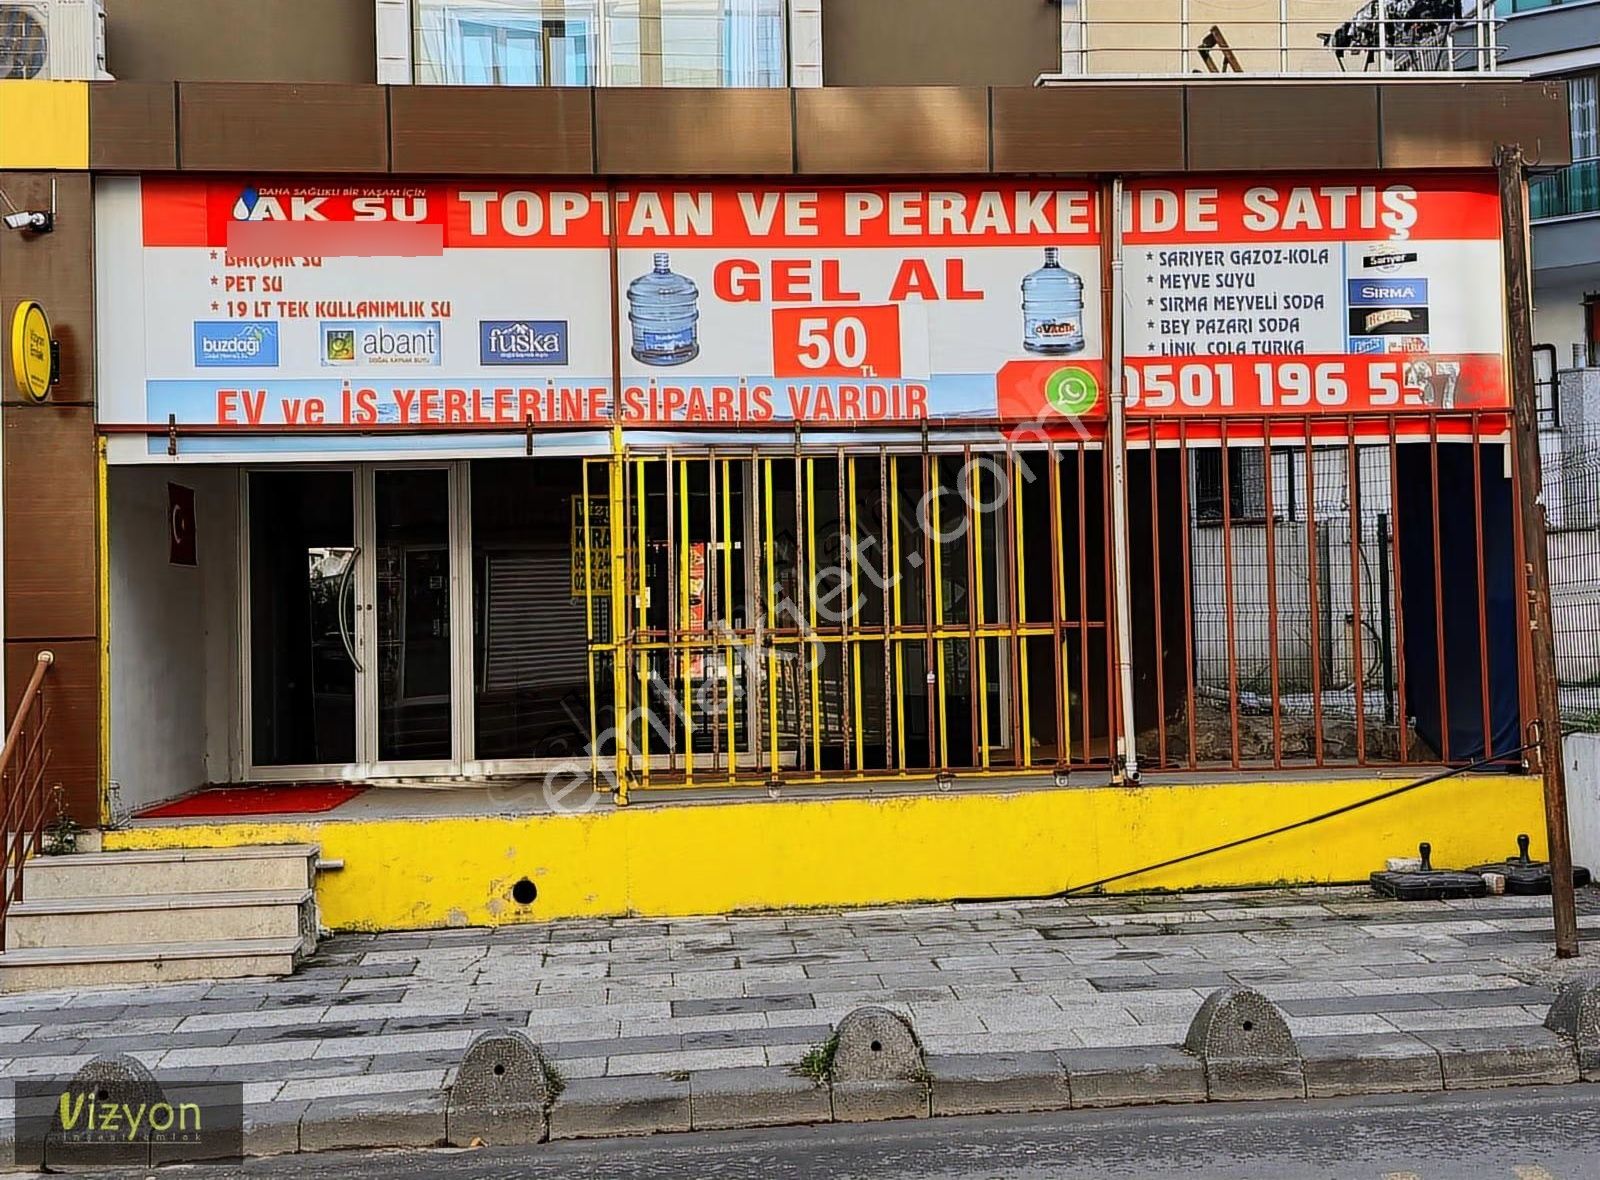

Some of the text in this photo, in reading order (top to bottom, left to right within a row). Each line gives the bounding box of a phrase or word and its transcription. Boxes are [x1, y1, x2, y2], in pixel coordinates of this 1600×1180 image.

[258, 187, 290, 197] DAHA
[249, 196, 428, 222] AK SU
[458, 190, 713, 237] TOPTAN
[737, 191, 819, 237] VE
[1242, 184, 1418, 241] SATIŞ
[1159, 249, 1329, 267] SARIYER GAZOZ-KOLA
[225, 275, 283, 292] PET SU
[713, 258, 985, 303] GEL AL
[1159, 272, 1256, 290] MEYVE SUYU
[227, 301, 451, 319] 19 LT TEK KULLANIMLIK SU
[1160, 291, 1325, 312] SIRMA MEYVELİ SODA
[1160, 317, 1300, 335] BEY PAZARI SODA
[202, 336, 261, 356] buzdağı
[363, 326, 436, 354] abant
[796, 316, 878, 378] 50 TL
[1206, 340, 1247, 356] COLA
[1251, 339, 1305, 356] TURKA
[1255, 362, 1348, 406] 196
[216, 388, 267, 425] EV
[281, 398, 325, 425] ve
[392, 379, 609, 424] YERLERİNE
[786, 384, 930, 420] VARDIR
